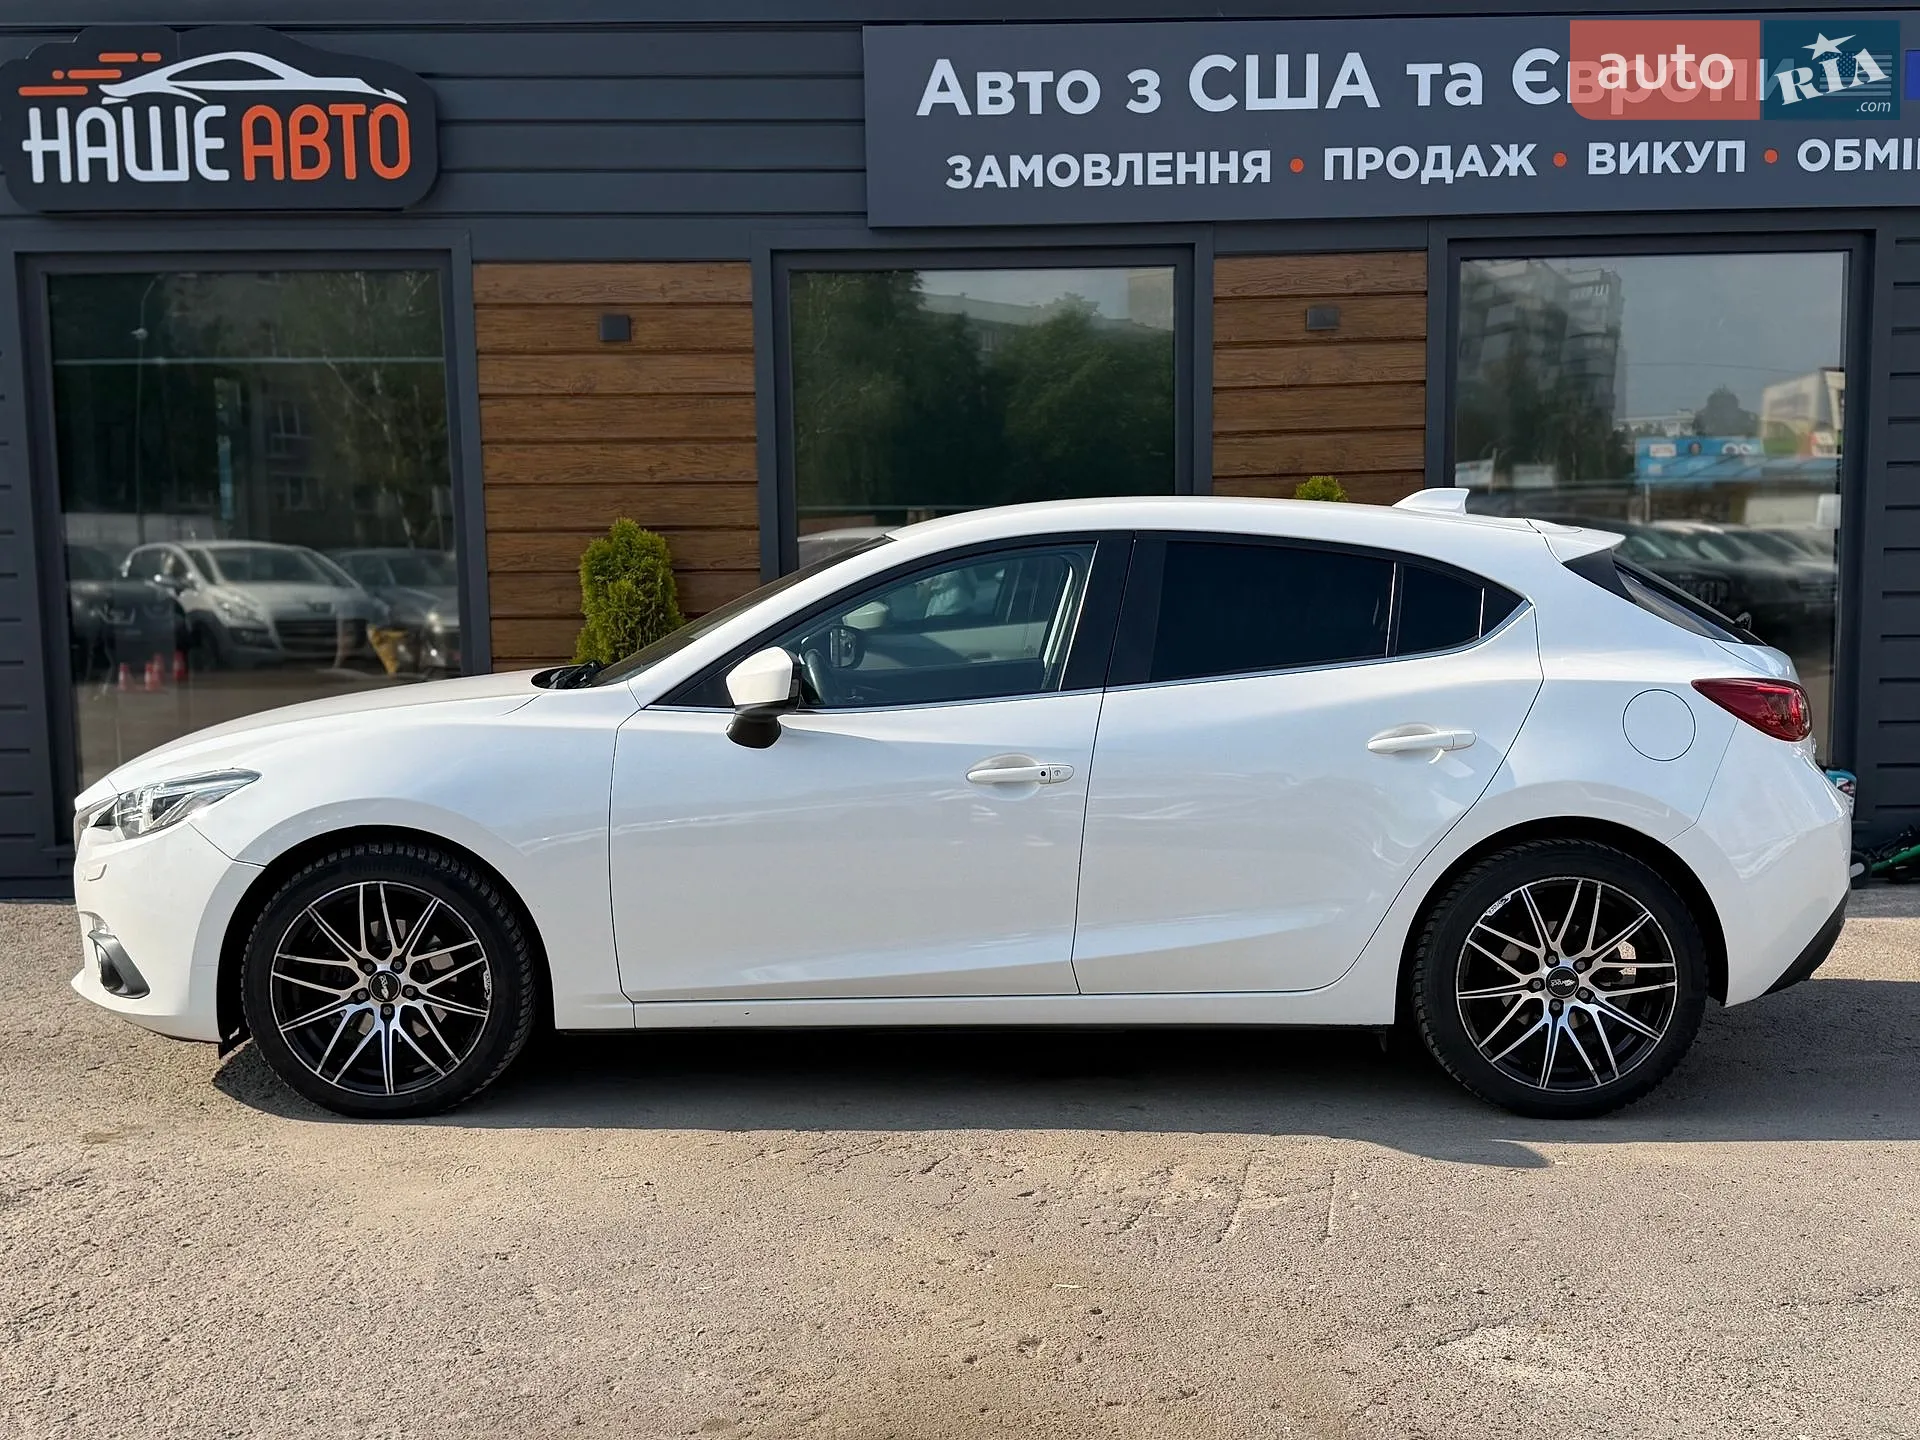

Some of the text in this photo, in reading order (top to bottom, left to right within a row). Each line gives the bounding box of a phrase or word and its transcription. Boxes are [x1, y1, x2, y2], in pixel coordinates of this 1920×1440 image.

[916, 58, 1101, 116] Авто
[1126, 69, 1161, 114] з
[1188, 52, 1381, 112] США
[1406, 61, 1483, 107] та
[22, 103, 411, 184] НАШЕ АВТО
[945, 137, 1920, 189] ЗАМОВЛЕННЯ ПРОДАЖ ВИКУП ОБМІ
